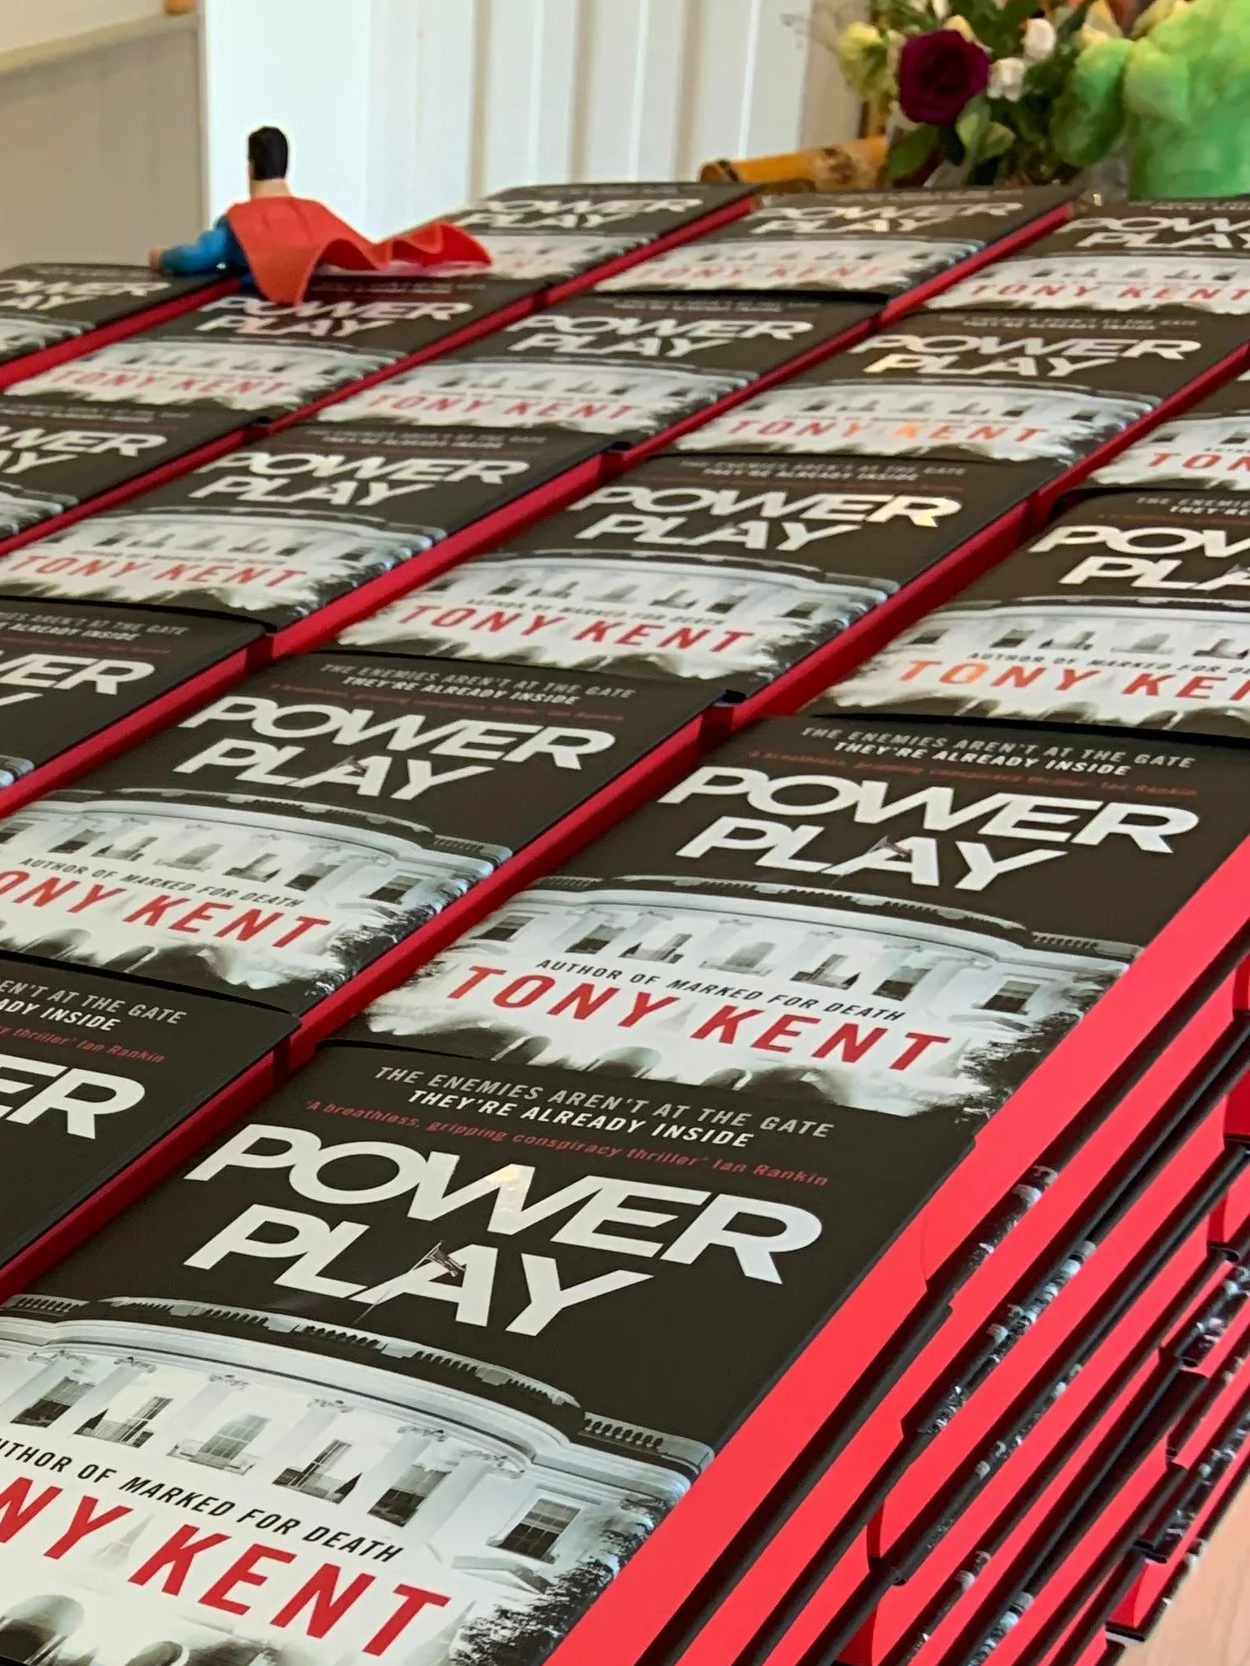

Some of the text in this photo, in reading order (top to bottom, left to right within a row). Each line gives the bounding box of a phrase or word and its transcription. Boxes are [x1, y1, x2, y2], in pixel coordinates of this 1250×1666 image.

[505, 315, 811, 338] POWER
[509, 334, 733, 356] PLAY
[851, 335, 1200, 357] POWER
[865, 355, 1117, 376] PLAY
[364, 394, 498, 410] TONY
[501, 401, 644, 417] KENT
[729, 418, 879, 434] TONY
[889, 424, 1049, 441] KENT
[195, 452, 528, 482] POWER
[189, 477, 435, 505] PLAY
[572, 485, 963, 524] POWER
[577, 514, 862, 550] PLAY
[8, 555, 154, 576] TONY
[151, 564, 308, 586] KENT
[398, 605, 757, 651] TONY KENT
[897, 660, 1102, 690] TONY
[178, 696, 615, 769] POWER
[802, 729, 1195, 767] THE ENEMIES AREN'T AT THE GATE
[174, 739, 495, 800] PLAY
[834, 742, 1130, 774] THEY'RE ALREADY INSIDE
[658, 766, 1200, 853] POWER
[677, 817, 1068, 890] PLAY
[121, 894, 333, 946] KENT
[45, 993, 77, 1004] AT
[80, 998, 123, 1013] THE
[126, 1008, 184, 1025] GATE
[535, 961, 907, 1019] AUTHOR OF MARKED FOR DEATH
[39, 1008, 119, 1030] INSIDE
[446, 967, 953, 1068] TONY KENT
[376, 1068, 832, 1140] THE ENEMIES AREN'T AT THE GATE
[408, 1090, 753, 1149] THEY'RE ALREADY INSIDE
[424, 1119, 511, 1140] gripping
[509, 1132, 623, 1157] conspiracy
[709, 1161, 750, 1174] Ian
[750, 1166, 833, 1187] Rankin
[187, 1123, 825, 1282] POWER
[186, 1205, 654, 1336] PLAY
[76, 1466, 114, 1482] OF
[117, 1478, 233, 1515] MARKED
[236, 1509, 299, 1534] FOR
[303, 1527, 404, 1561] DEATH
[127, 1524, 453, 1653] KENT
